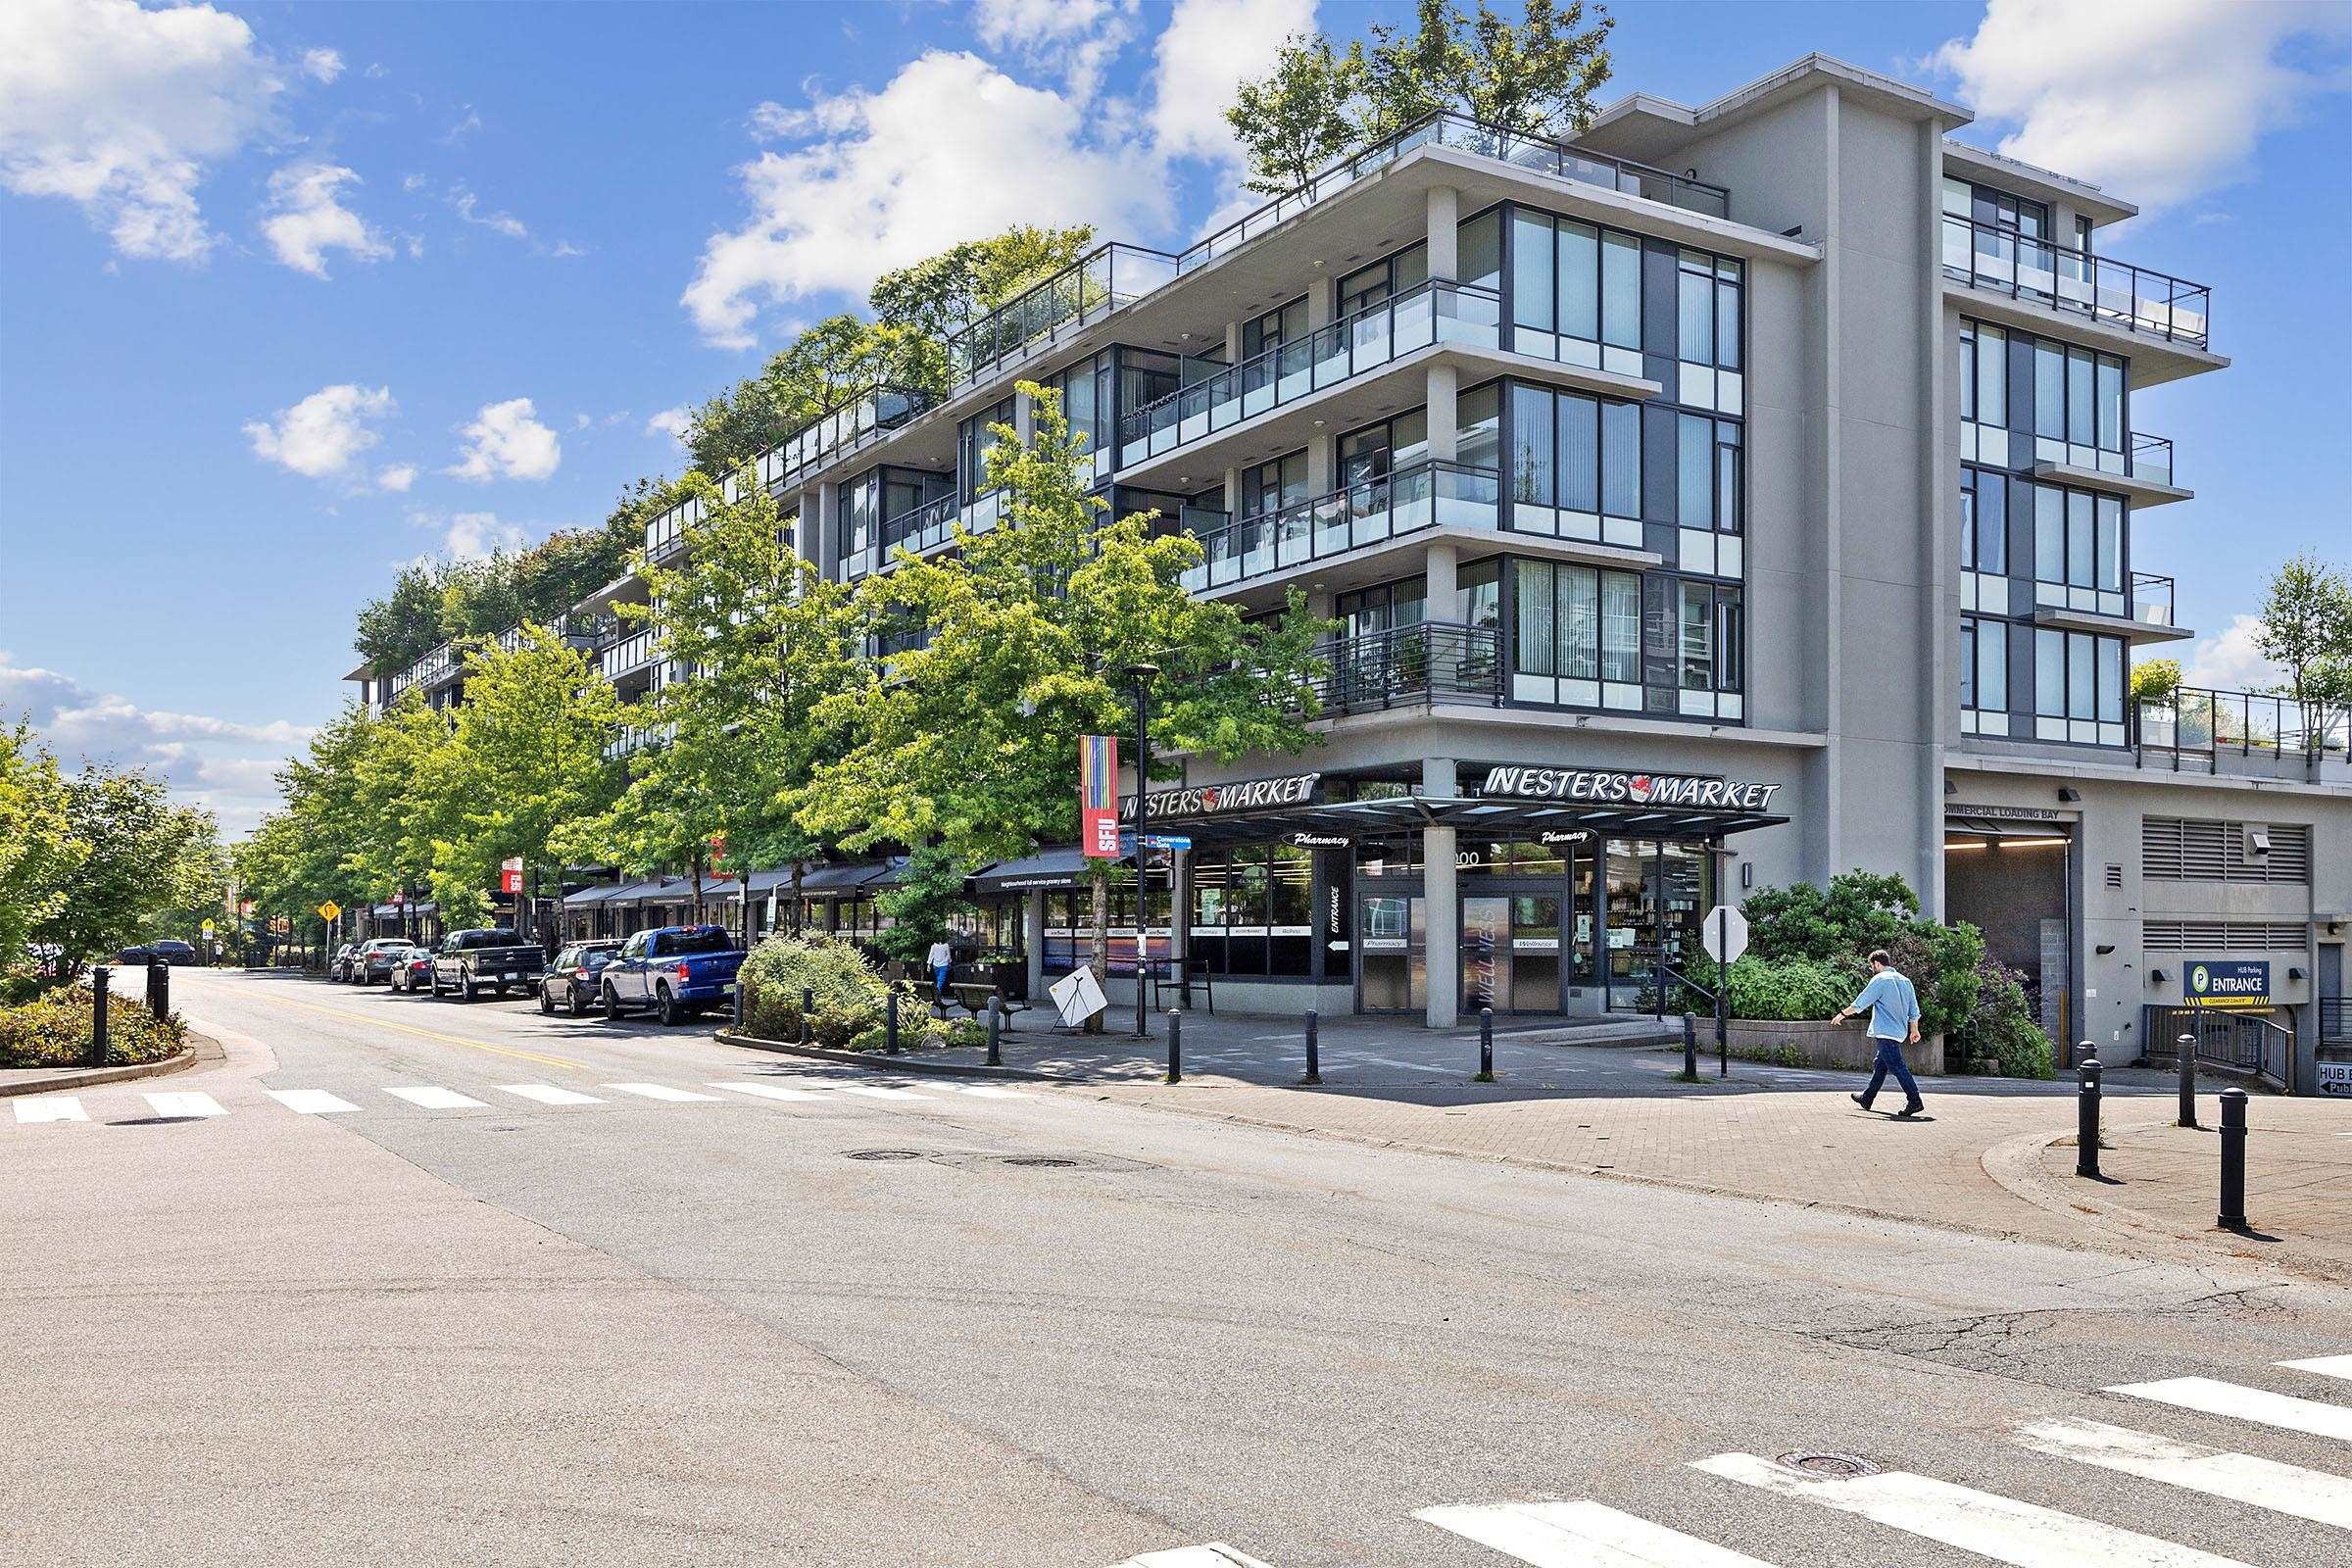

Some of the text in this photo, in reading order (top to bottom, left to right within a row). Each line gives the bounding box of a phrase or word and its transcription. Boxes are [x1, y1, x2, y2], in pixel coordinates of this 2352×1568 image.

[1216, 772, 1317, 811] MARKET
[1485, 767, 1782, 809] NESTERS MARKET
[1999, 808, 2039, 818] LOADING
[2041, 810, 2059, 819] BAY
[1098, 818, 1116, 852] SFU
[1156, 835, 1192, 844] Cornerstone
[1294, 832, 1349, 848] Pharmacy
[1542, 831, 1588, 845] Pharmacy
[1331, 885, 1340, 933] ENTRANCE
[2247, 966, 2262, 976] Parking
[2212, 977, 2262, 992] ENTRANCE
[2320, 1067, 2345, 1080] HUB
